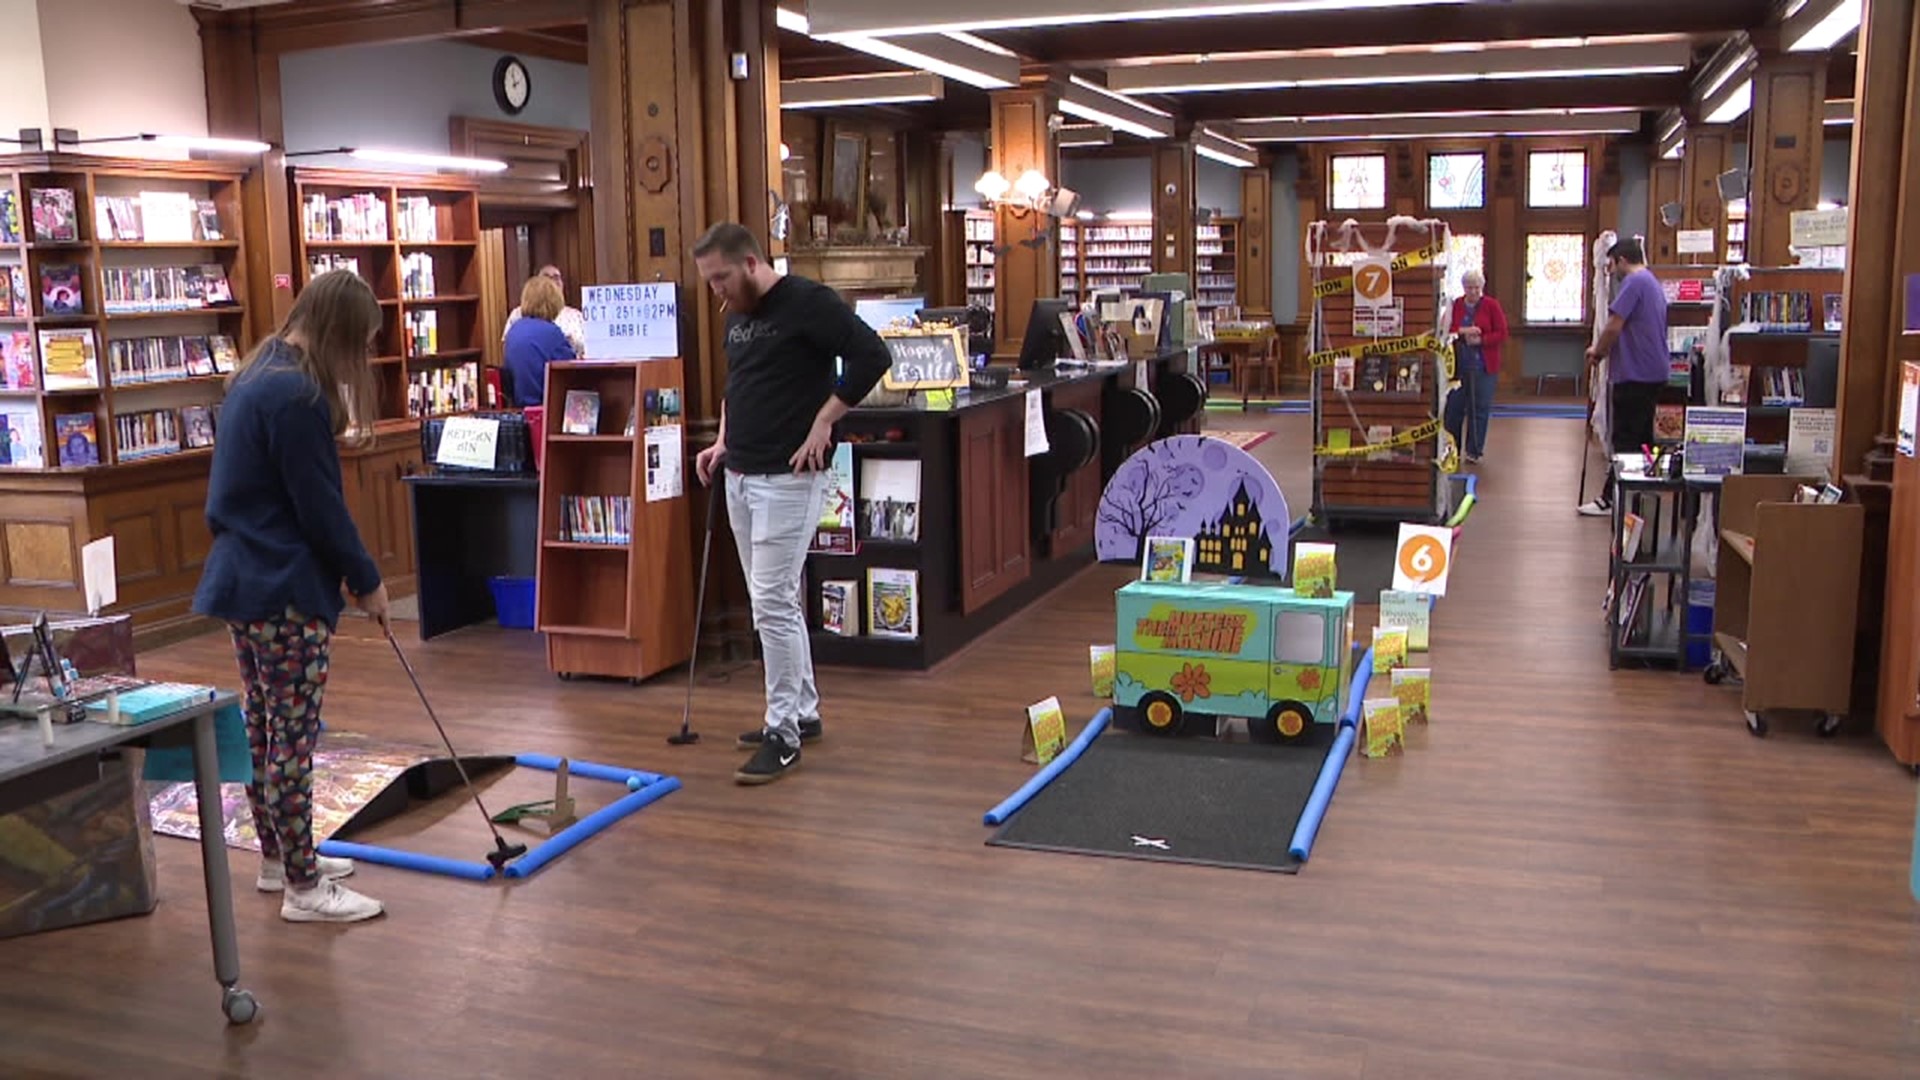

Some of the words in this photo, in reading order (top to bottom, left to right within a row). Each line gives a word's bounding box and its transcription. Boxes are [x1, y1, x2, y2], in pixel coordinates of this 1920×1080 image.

[1366, 271, 1381, 292] 7
[588, 286, 658, 302] WEDNESDAY
[582, 305, 606, 321] OCT
[609, 324, 648, 337] BARBIE
[893, 343, 943, 364] Happy
[1362, 337, 1418, 354] CAUTION
[1411, 544, 1433, 572] 6
[1166, 610, 1247, 635] MYSTERY
[1161, 627, 1243, 654] MACHINE
